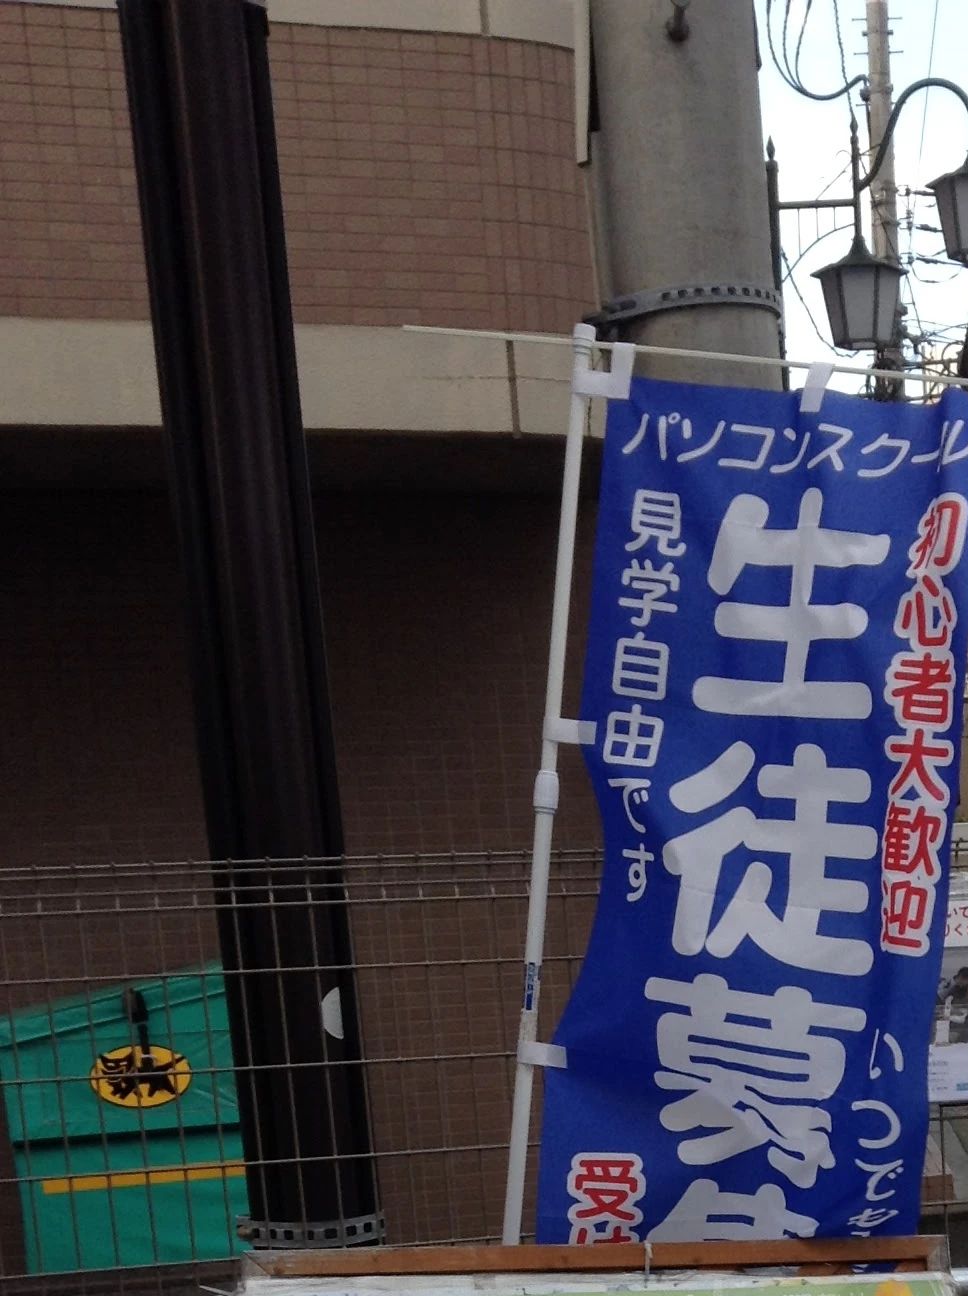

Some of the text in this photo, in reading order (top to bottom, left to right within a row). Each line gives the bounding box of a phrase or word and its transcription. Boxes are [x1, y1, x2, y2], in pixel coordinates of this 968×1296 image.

[603, 488, 687, 903] 見学自由です
[644, 487, 891, 1241] 生徒募
